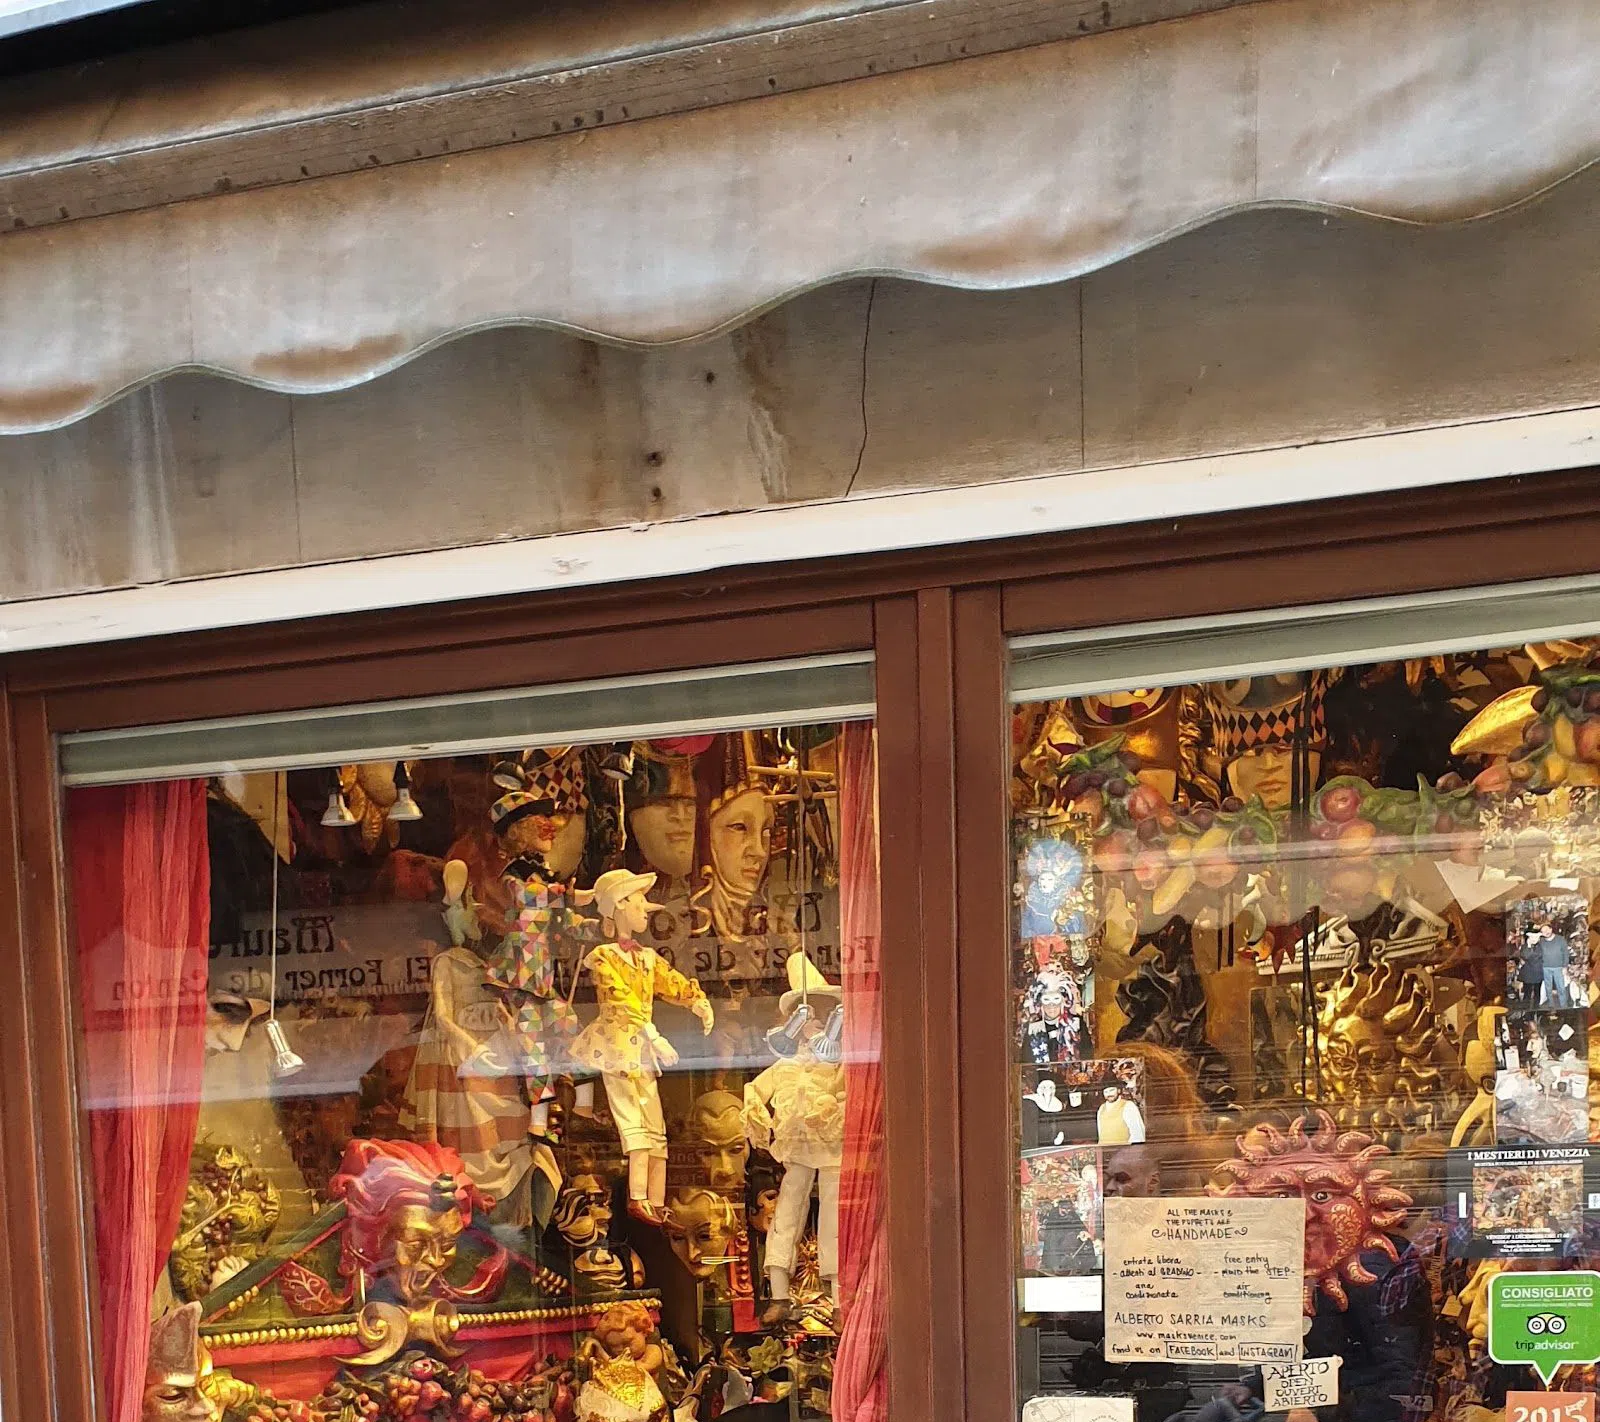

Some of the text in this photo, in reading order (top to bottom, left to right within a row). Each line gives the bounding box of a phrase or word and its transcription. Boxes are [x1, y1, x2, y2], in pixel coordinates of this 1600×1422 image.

[1467, 1148, 1590, 1160] I MESTIERI DI VENEZIA
[1184, 1208, 1197, 1216] THE
[1167, 1227, 1234, 1240] HANDMADE
[1245, 1252, 1270, 1269] entry
[1265, 1266, 1290, 1277] STEP
[1501, 1287, 1593, 1298] CONSIGLIATO
[1114, 1312, 1267, 1328] ALBERTO SARRIA MASKS
[1169, 1345, 1215, 1357] FACEBOOK
[1239, 1345, 1293, 1358] INSTAGRAM
[1515, 1340, 1575, 1351] tripadvisor
[1267, 1362, 1330, 1381] APERTO
[1281, 1377, 1314, 1388] OPEN
[1276, 1385, 1322, 1397] OUVERT
[1271, 1393, 1328, 1408] ABIERTO
